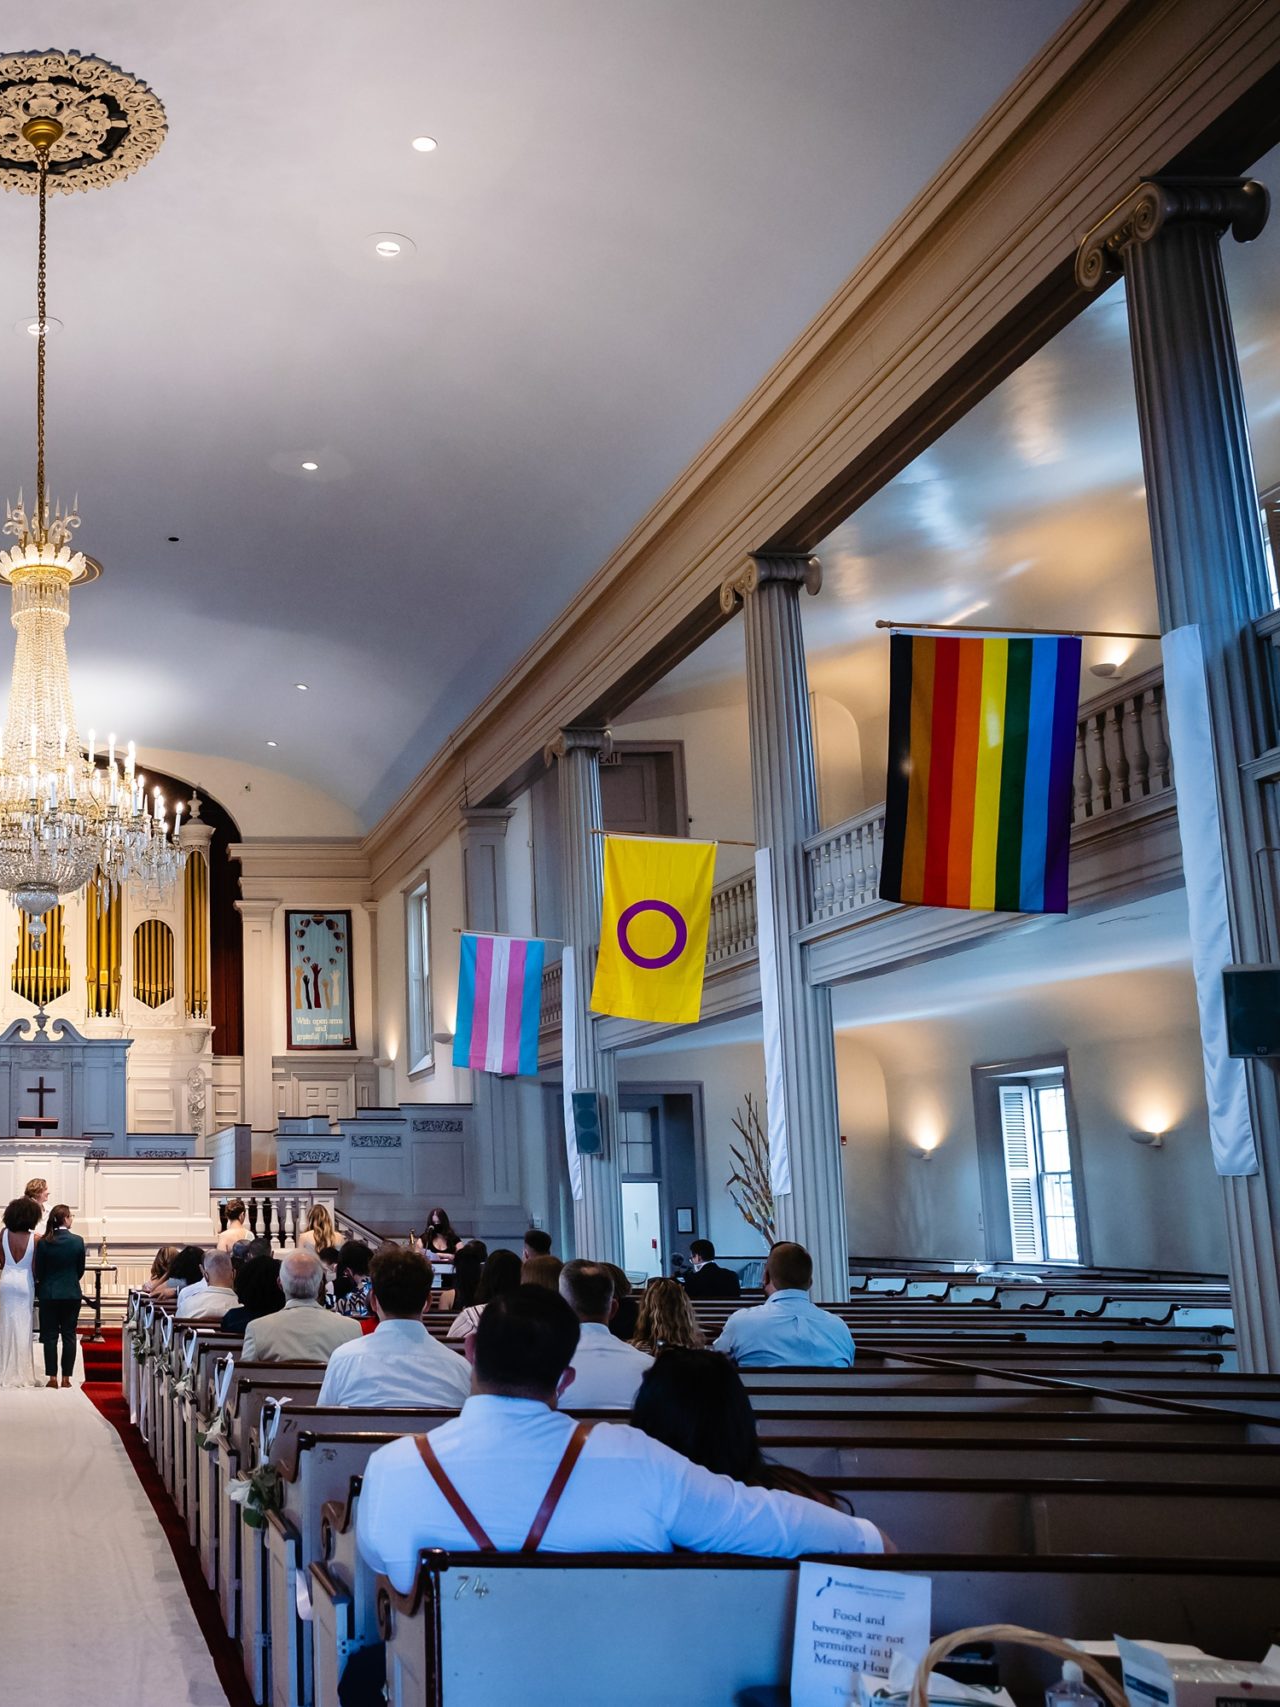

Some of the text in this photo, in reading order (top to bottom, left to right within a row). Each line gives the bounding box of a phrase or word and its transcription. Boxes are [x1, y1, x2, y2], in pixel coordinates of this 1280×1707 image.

[454, 1575, 490, 1601] 74
[832, 1607, 886, 1626] Food and
[811, 1620, 905, 1644] beverages are not
[813, 1639, 866, 1655] permitted
[870, 1647, 881, 1657] in
[814, 1652, 860, 1672] Meeting
